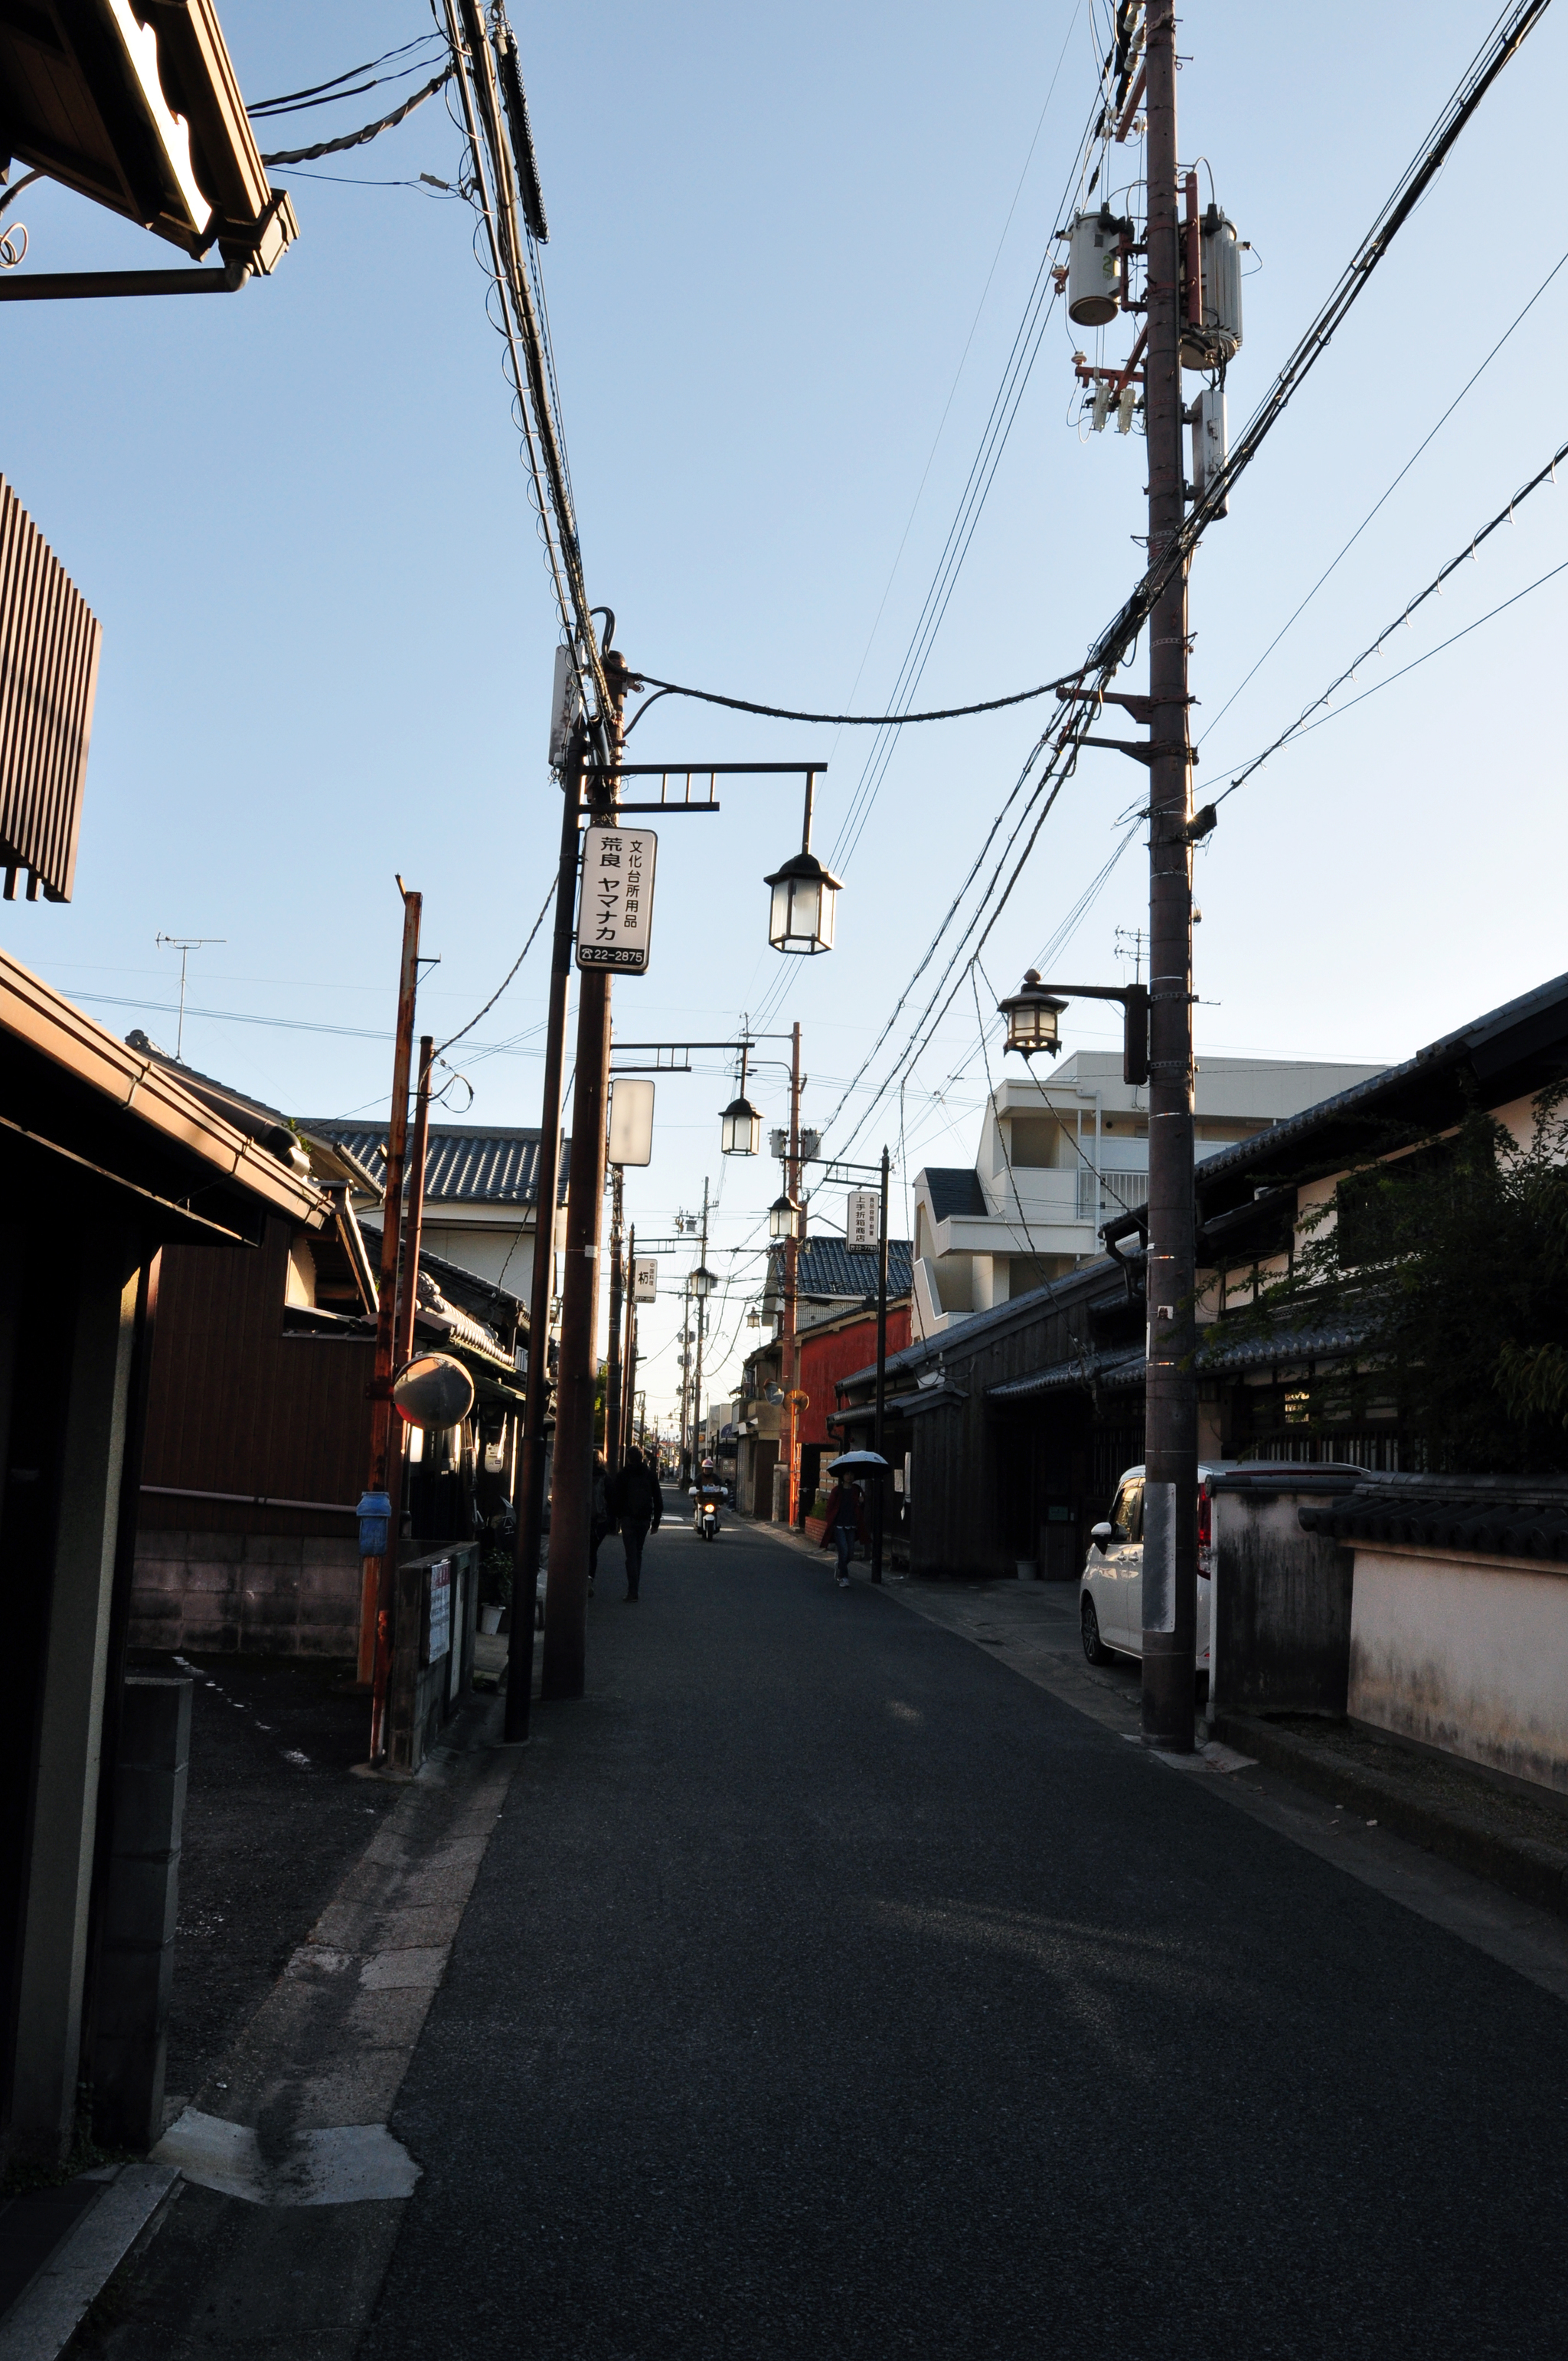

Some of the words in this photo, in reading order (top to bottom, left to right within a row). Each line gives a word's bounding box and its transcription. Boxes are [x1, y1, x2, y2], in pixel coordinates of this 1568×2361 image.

[599, 836, 622, 868] 荒良
[624, 840, 643, 928] 文化台所用品
[595, 877, 620, 941] ヤマナカ
[594, 949, 643, 963] 22-2875
[855, 1195, 866, 1242] 上手折箱商店
